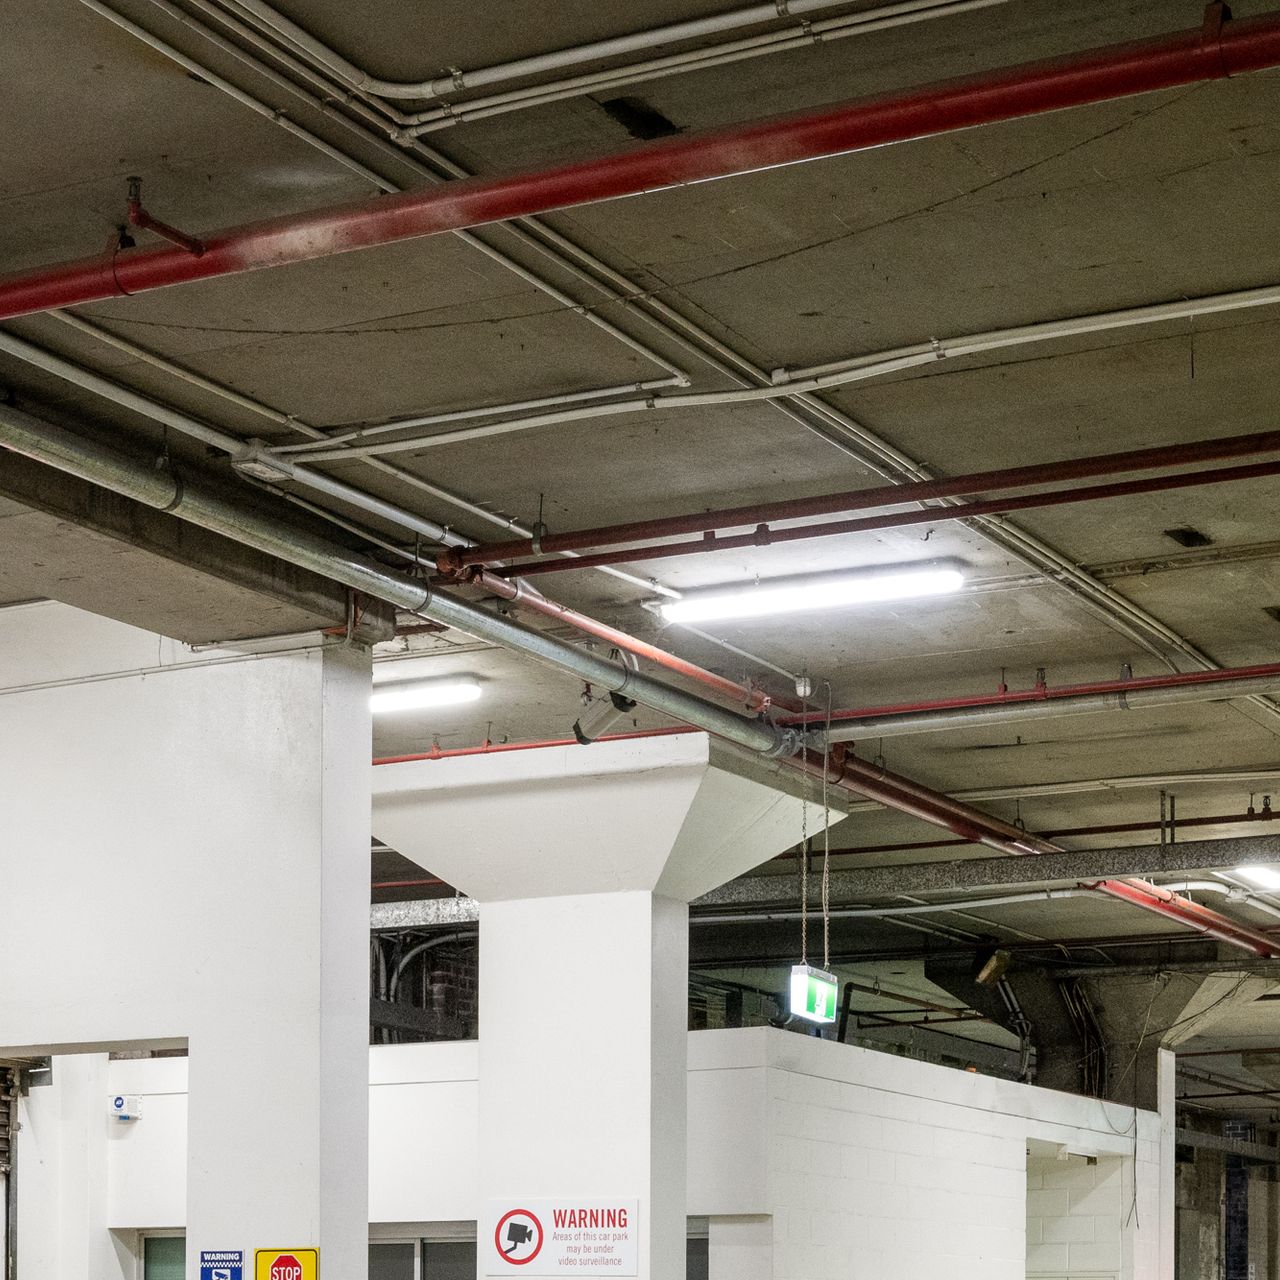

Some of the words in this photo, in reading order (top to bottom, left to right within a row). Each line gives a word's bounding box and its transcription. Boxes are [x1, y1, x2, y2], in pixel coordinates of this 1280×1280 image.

[553, 1209, 628, 1228] WARNING
[552, 1232, 572, 1241] Areas
[575, 1232, 581, 1241] of
[583, 1232, 596, 1241] this
[612, 1232, 628, 1243] park
[566, 1246, 580, 1255] may
[583, 1245, 592, 1253] be
[594, 1245, 614, 1253] under
[558, 1257, 577, 1266] video
[579, 1257, 622, 1266] surveillance
